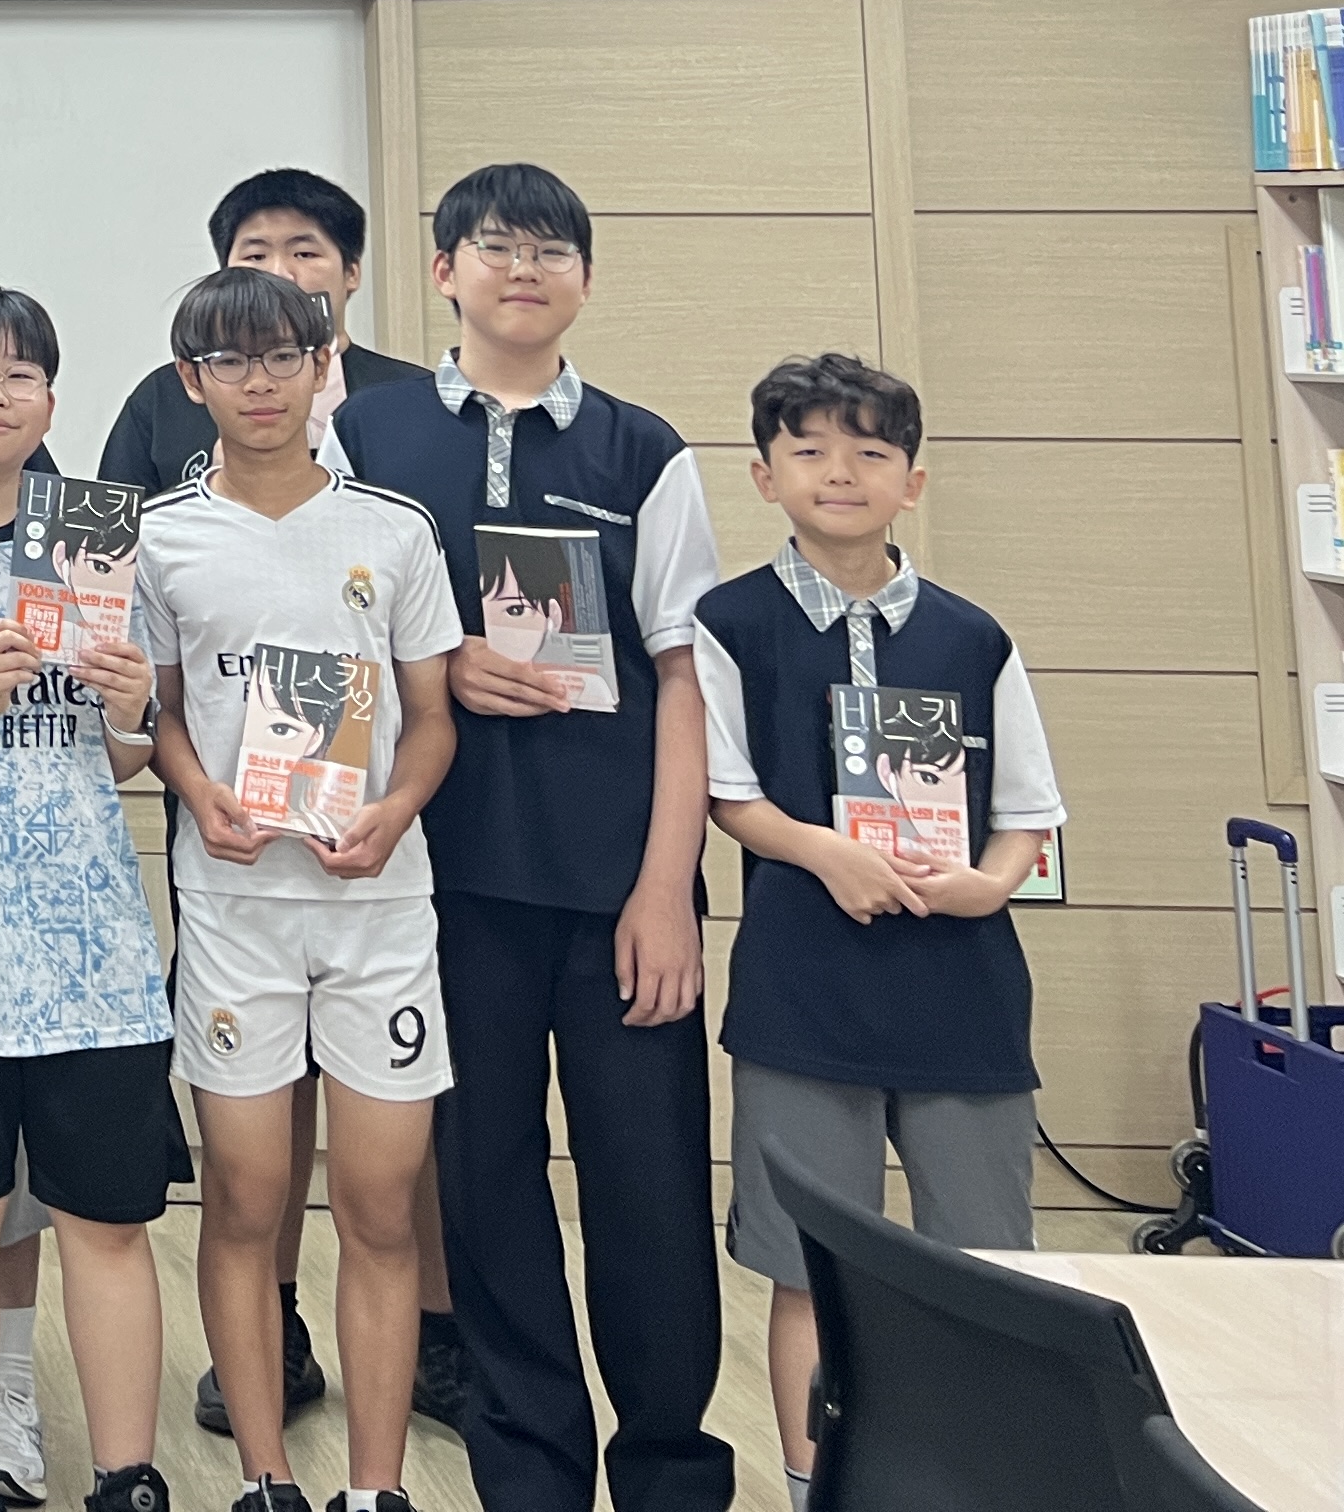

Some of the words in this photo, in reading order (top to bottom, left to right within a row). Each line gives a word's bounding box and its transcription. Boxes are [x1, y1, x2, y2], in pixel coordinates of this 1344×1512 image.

[26, 476, 140, 535] 비스킷
[258, 648, 371, 707] 비스킷
[1, 713, 78, 749] BETTER
[838, 690, 959, 743] 비스킷
[388, 1005, 427, 1069] 9
